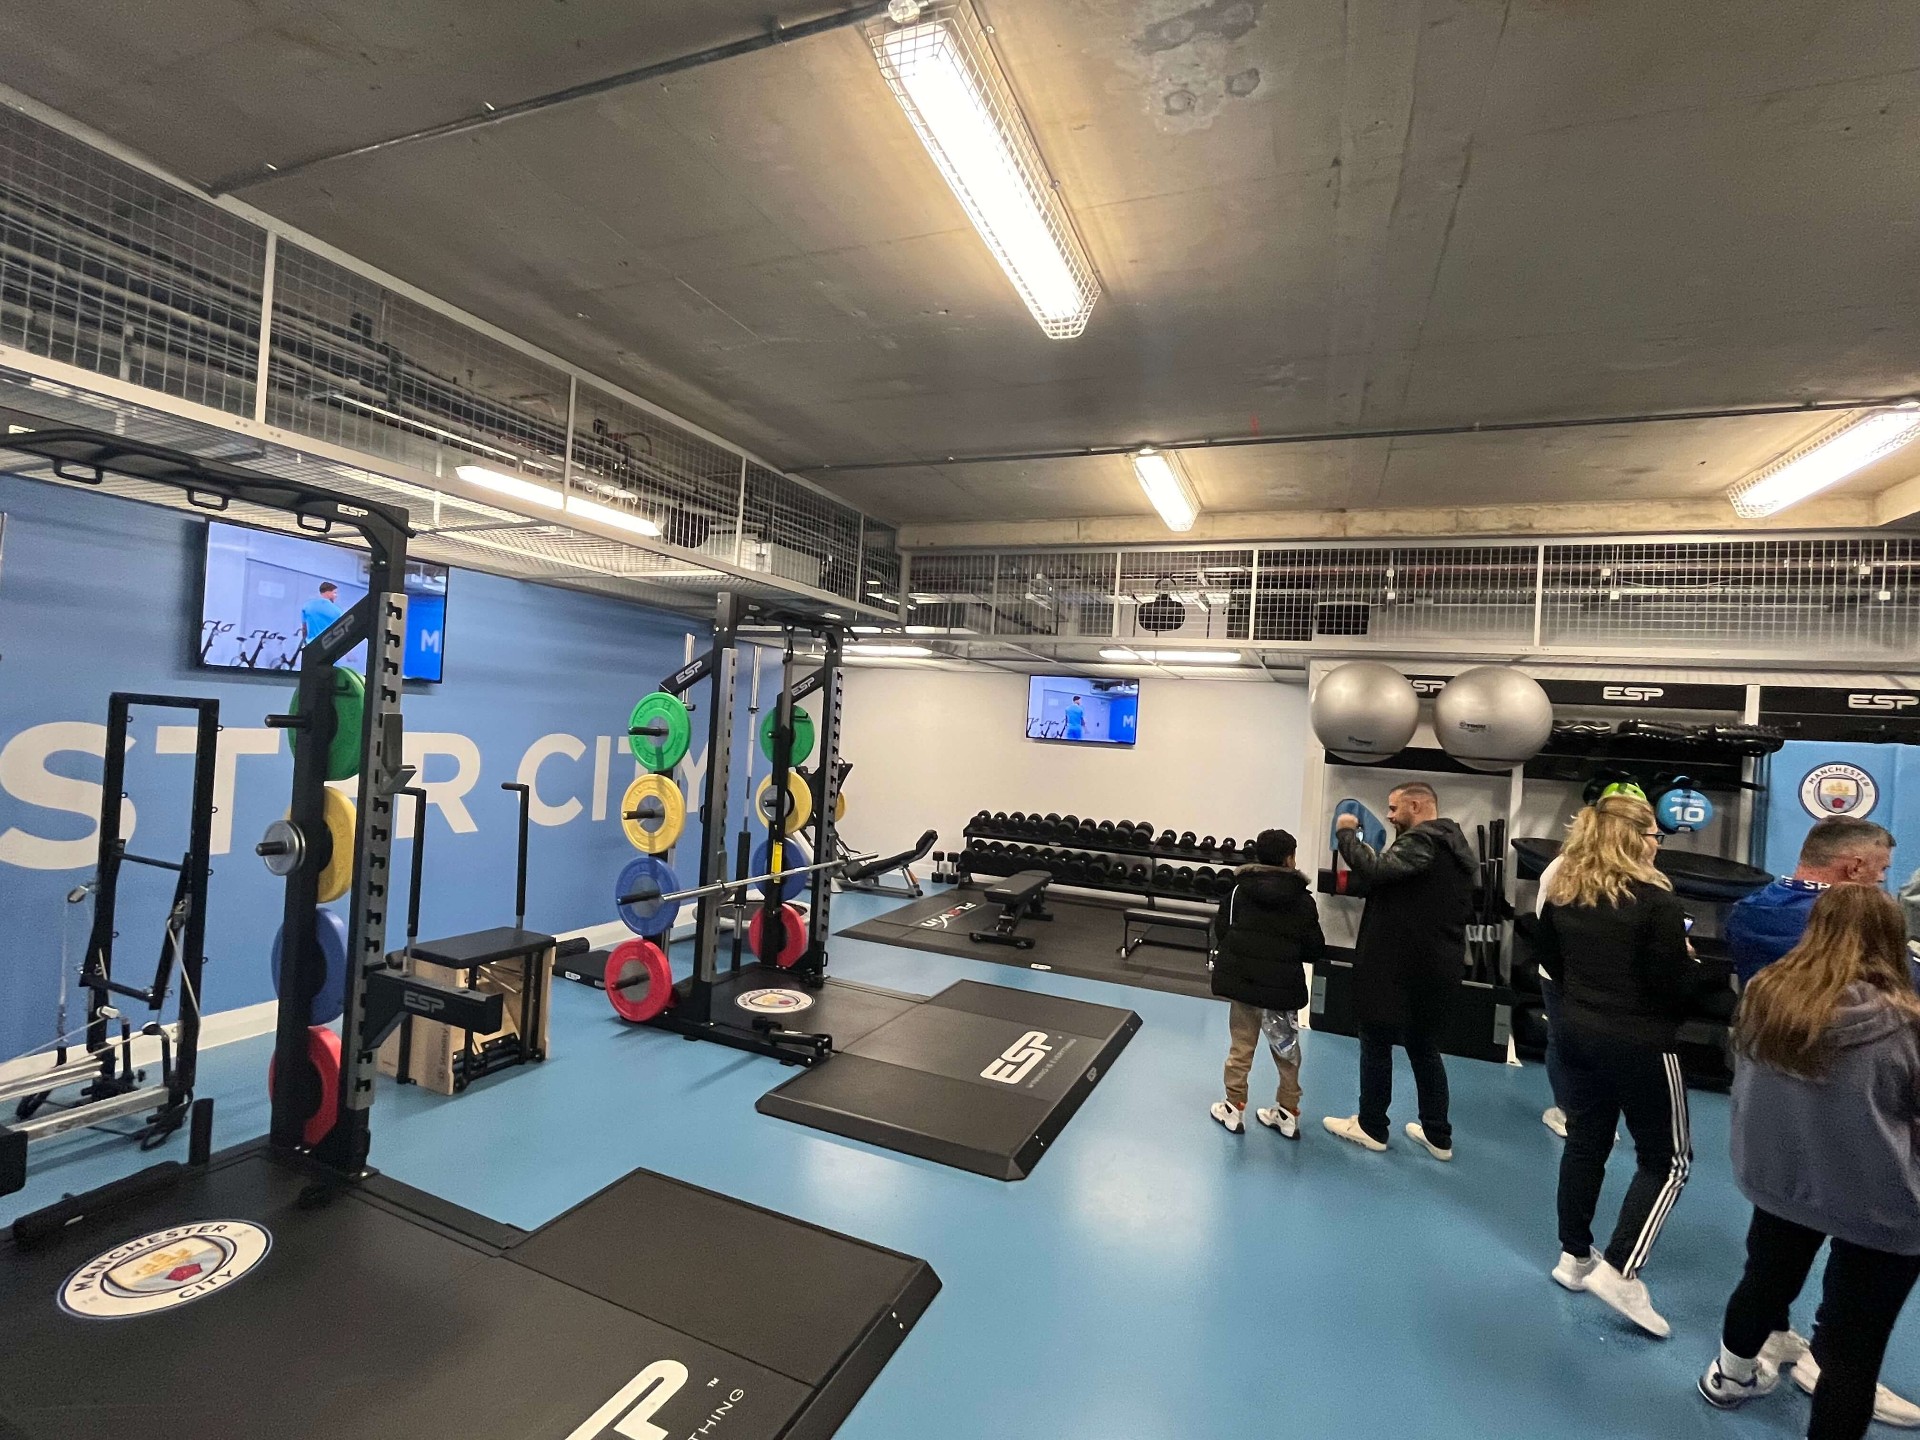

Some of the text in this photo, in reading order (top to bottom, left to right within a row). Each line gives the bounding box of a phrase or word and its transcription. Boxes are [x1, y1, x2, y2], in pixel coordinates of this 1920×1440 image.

[338, 504, 368, 517] ESP
[321, 604, 355, 650] ESP
[420, 628, 440, 654] M
[676, 660, 703, 684] ESP
[791, 676, 815, 697] ESP
[1407, 679, 1447, 693] SP
[1602, 686, 1664, 702] ESP
[1847, 694, 1920, 710] ESP
[1122, 714, 1134, 728] M
[1808, 766, 1871, 787] MANCHESTER
[0, 720, 479, 870] STR
[1669, 806, 1705, 822] 10
[403, 990, 445, 1013] ESP
[980, 1030, 1053, 1085] ESP
[73, 1224, 229, 1292] MANCHESTER
[178, 1269, 235, 1300] CITY
